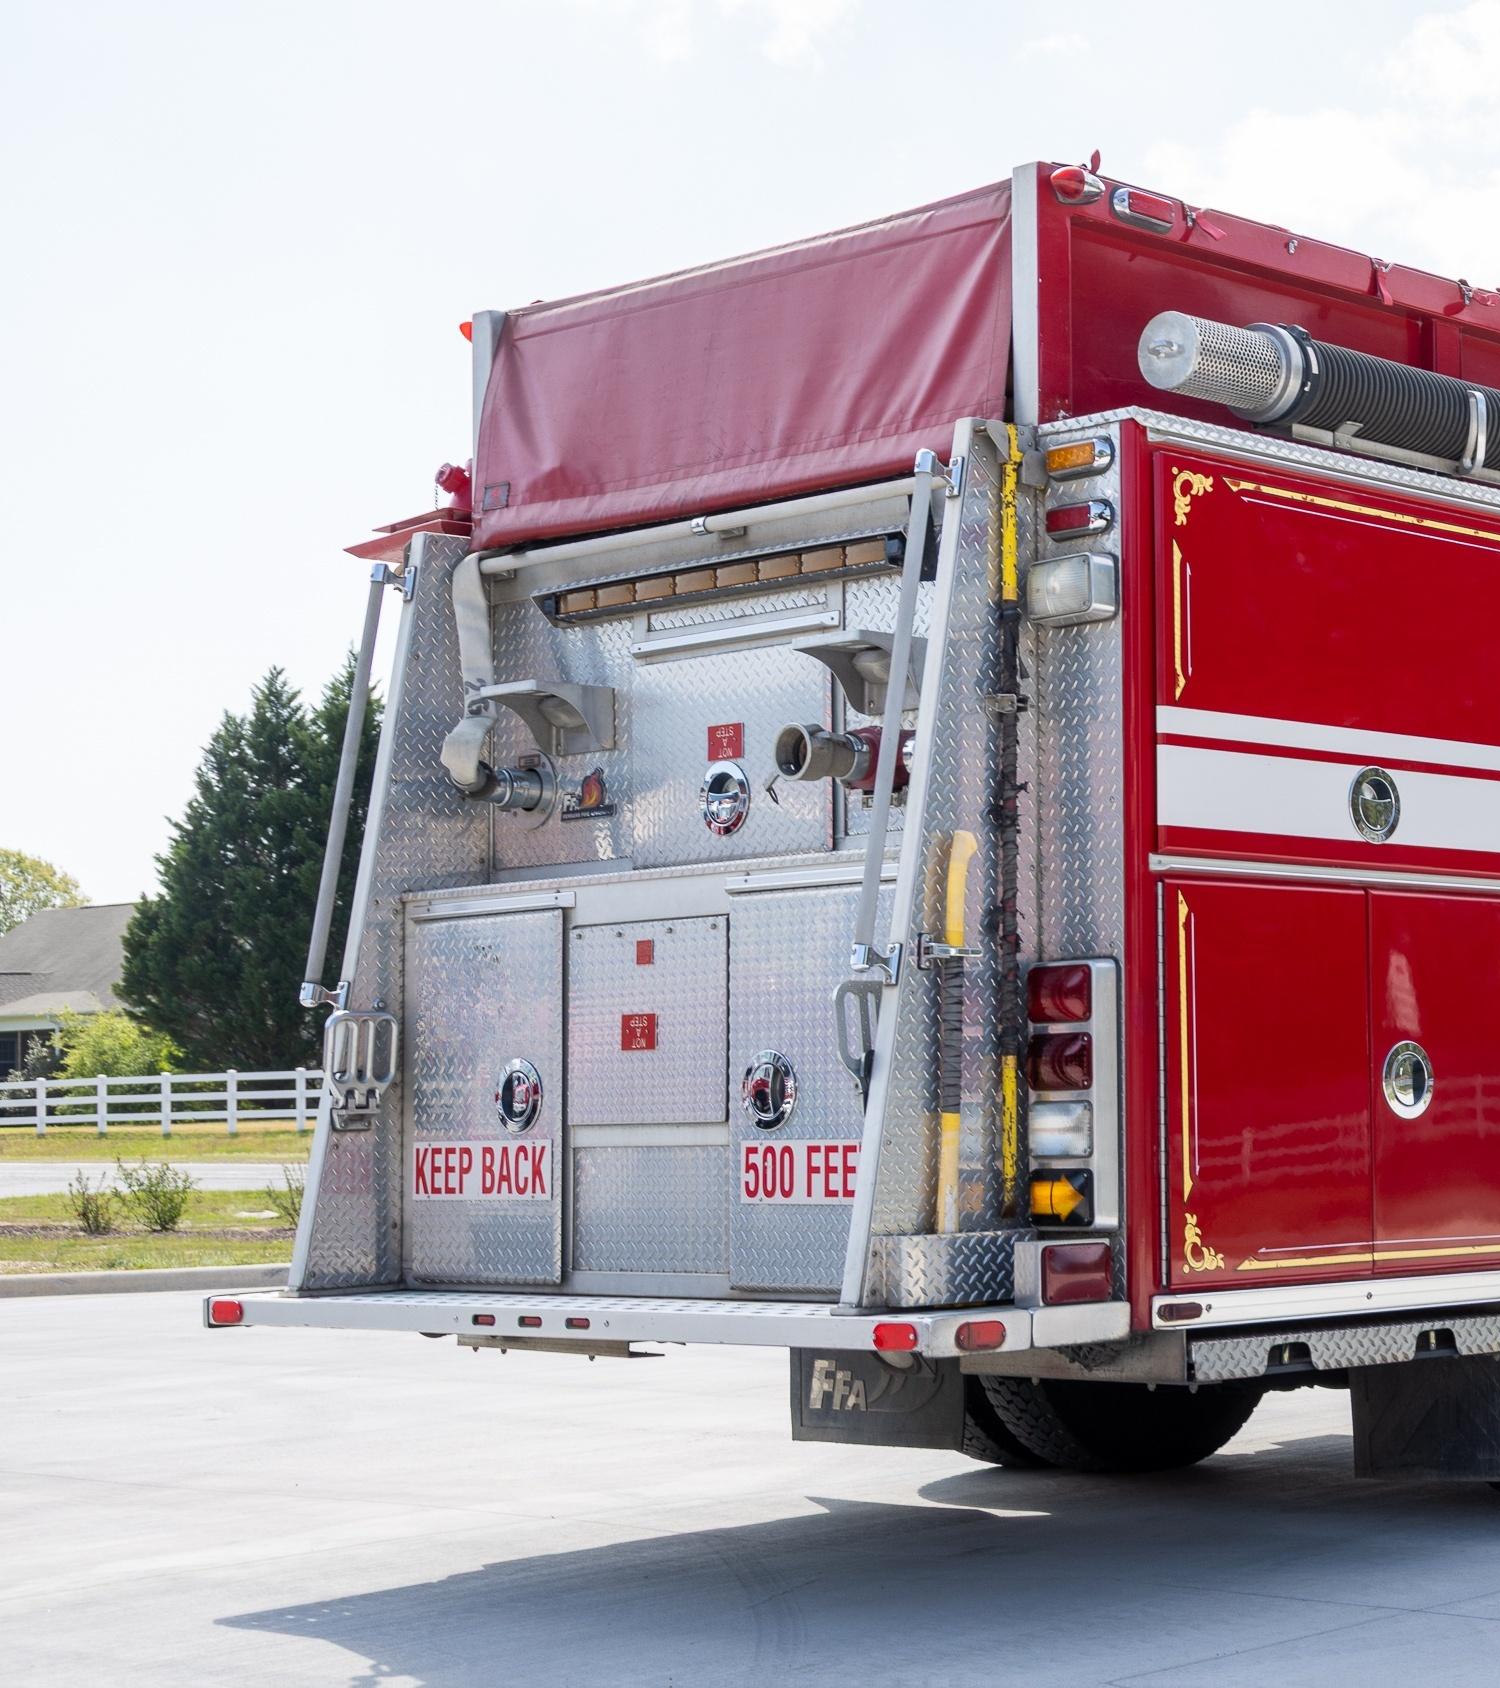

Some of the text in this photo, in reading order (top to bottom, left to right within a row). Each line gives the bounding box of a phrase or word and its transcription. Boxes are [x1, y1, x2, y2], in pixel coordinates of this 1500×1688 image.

[715, 726, 734, 738] STEP
[722, 738, 728, 747] A
[717, 747, 732, 758] NOT
[630, 1016, 648, 1027] STEP
[636, 1028, 642, 1038] A
[631, 1038, 646, 1049] NOT
[415, 1145, 547, 1196] KEEP BACK
[745, 1145, 861, 1198] 500 FEE
[809, 1359, 868, 1412] FFA
